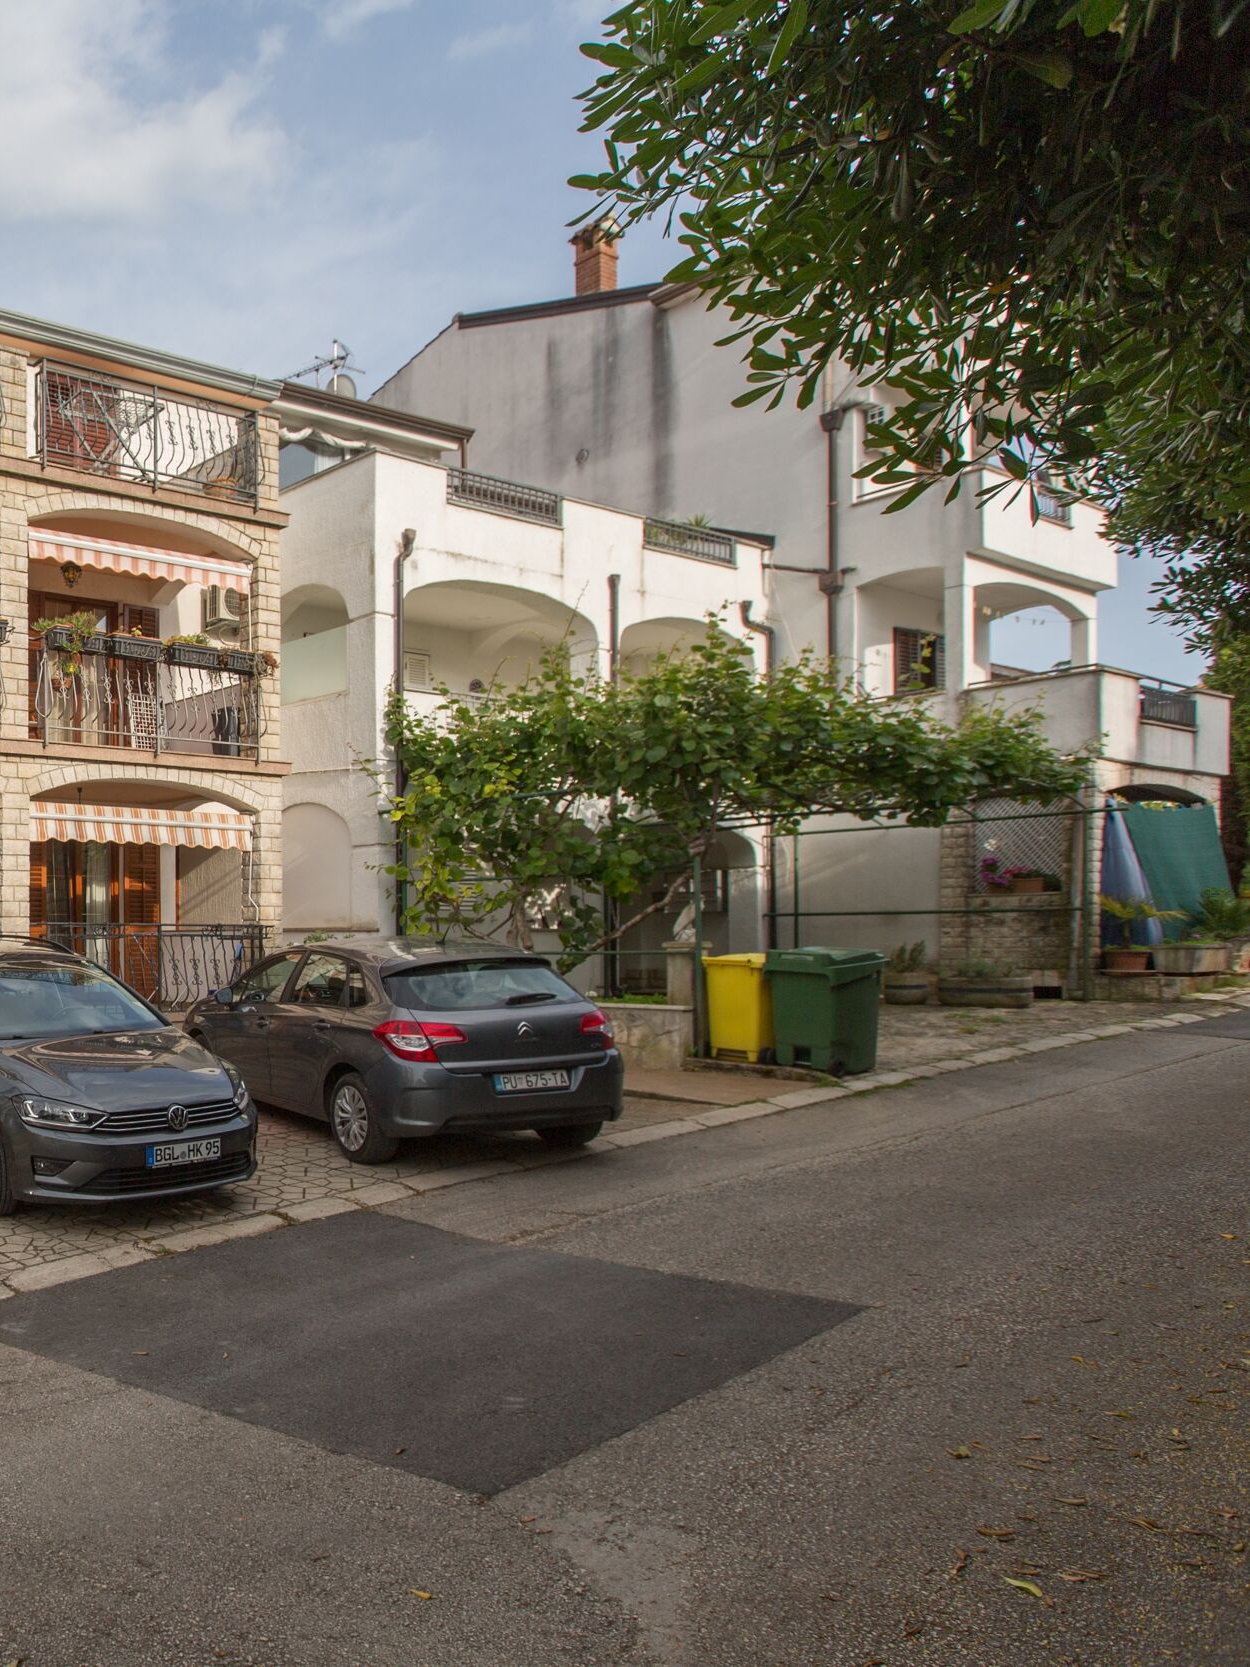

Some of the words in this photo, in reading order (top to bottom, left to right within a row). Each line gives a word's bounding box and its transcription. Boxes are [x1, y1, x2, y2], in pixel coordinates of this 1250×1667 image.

[503, 1075, 518, 1089] PU
[155, 1147, 179, 1162] BGL
[187, 1143, 203, 1158] HK
[205, 1140, 219, 1156] 95
